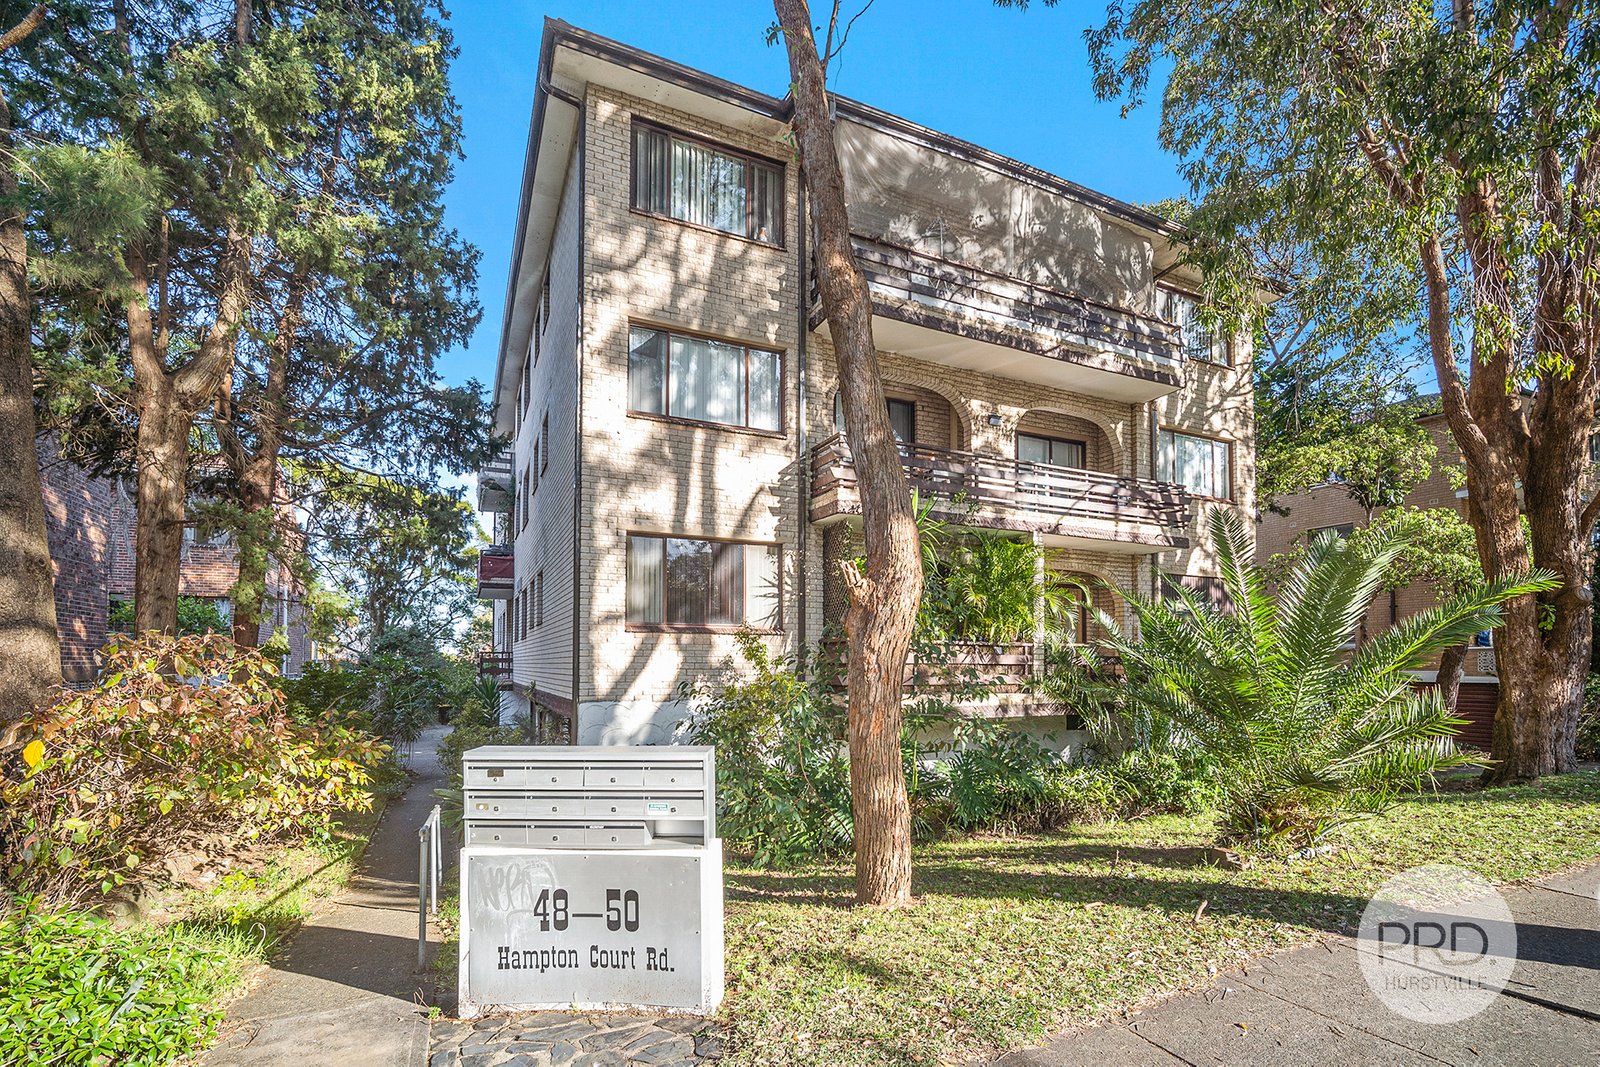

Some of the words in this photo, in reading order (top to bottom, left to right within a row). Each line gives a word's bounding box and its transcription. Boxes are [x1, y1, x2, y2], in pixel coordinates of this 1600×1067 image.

[497, 945, 579, 973] Hampton
[589, 944, 636, 970] Court
[646, 947, 675, 972] Rd.
